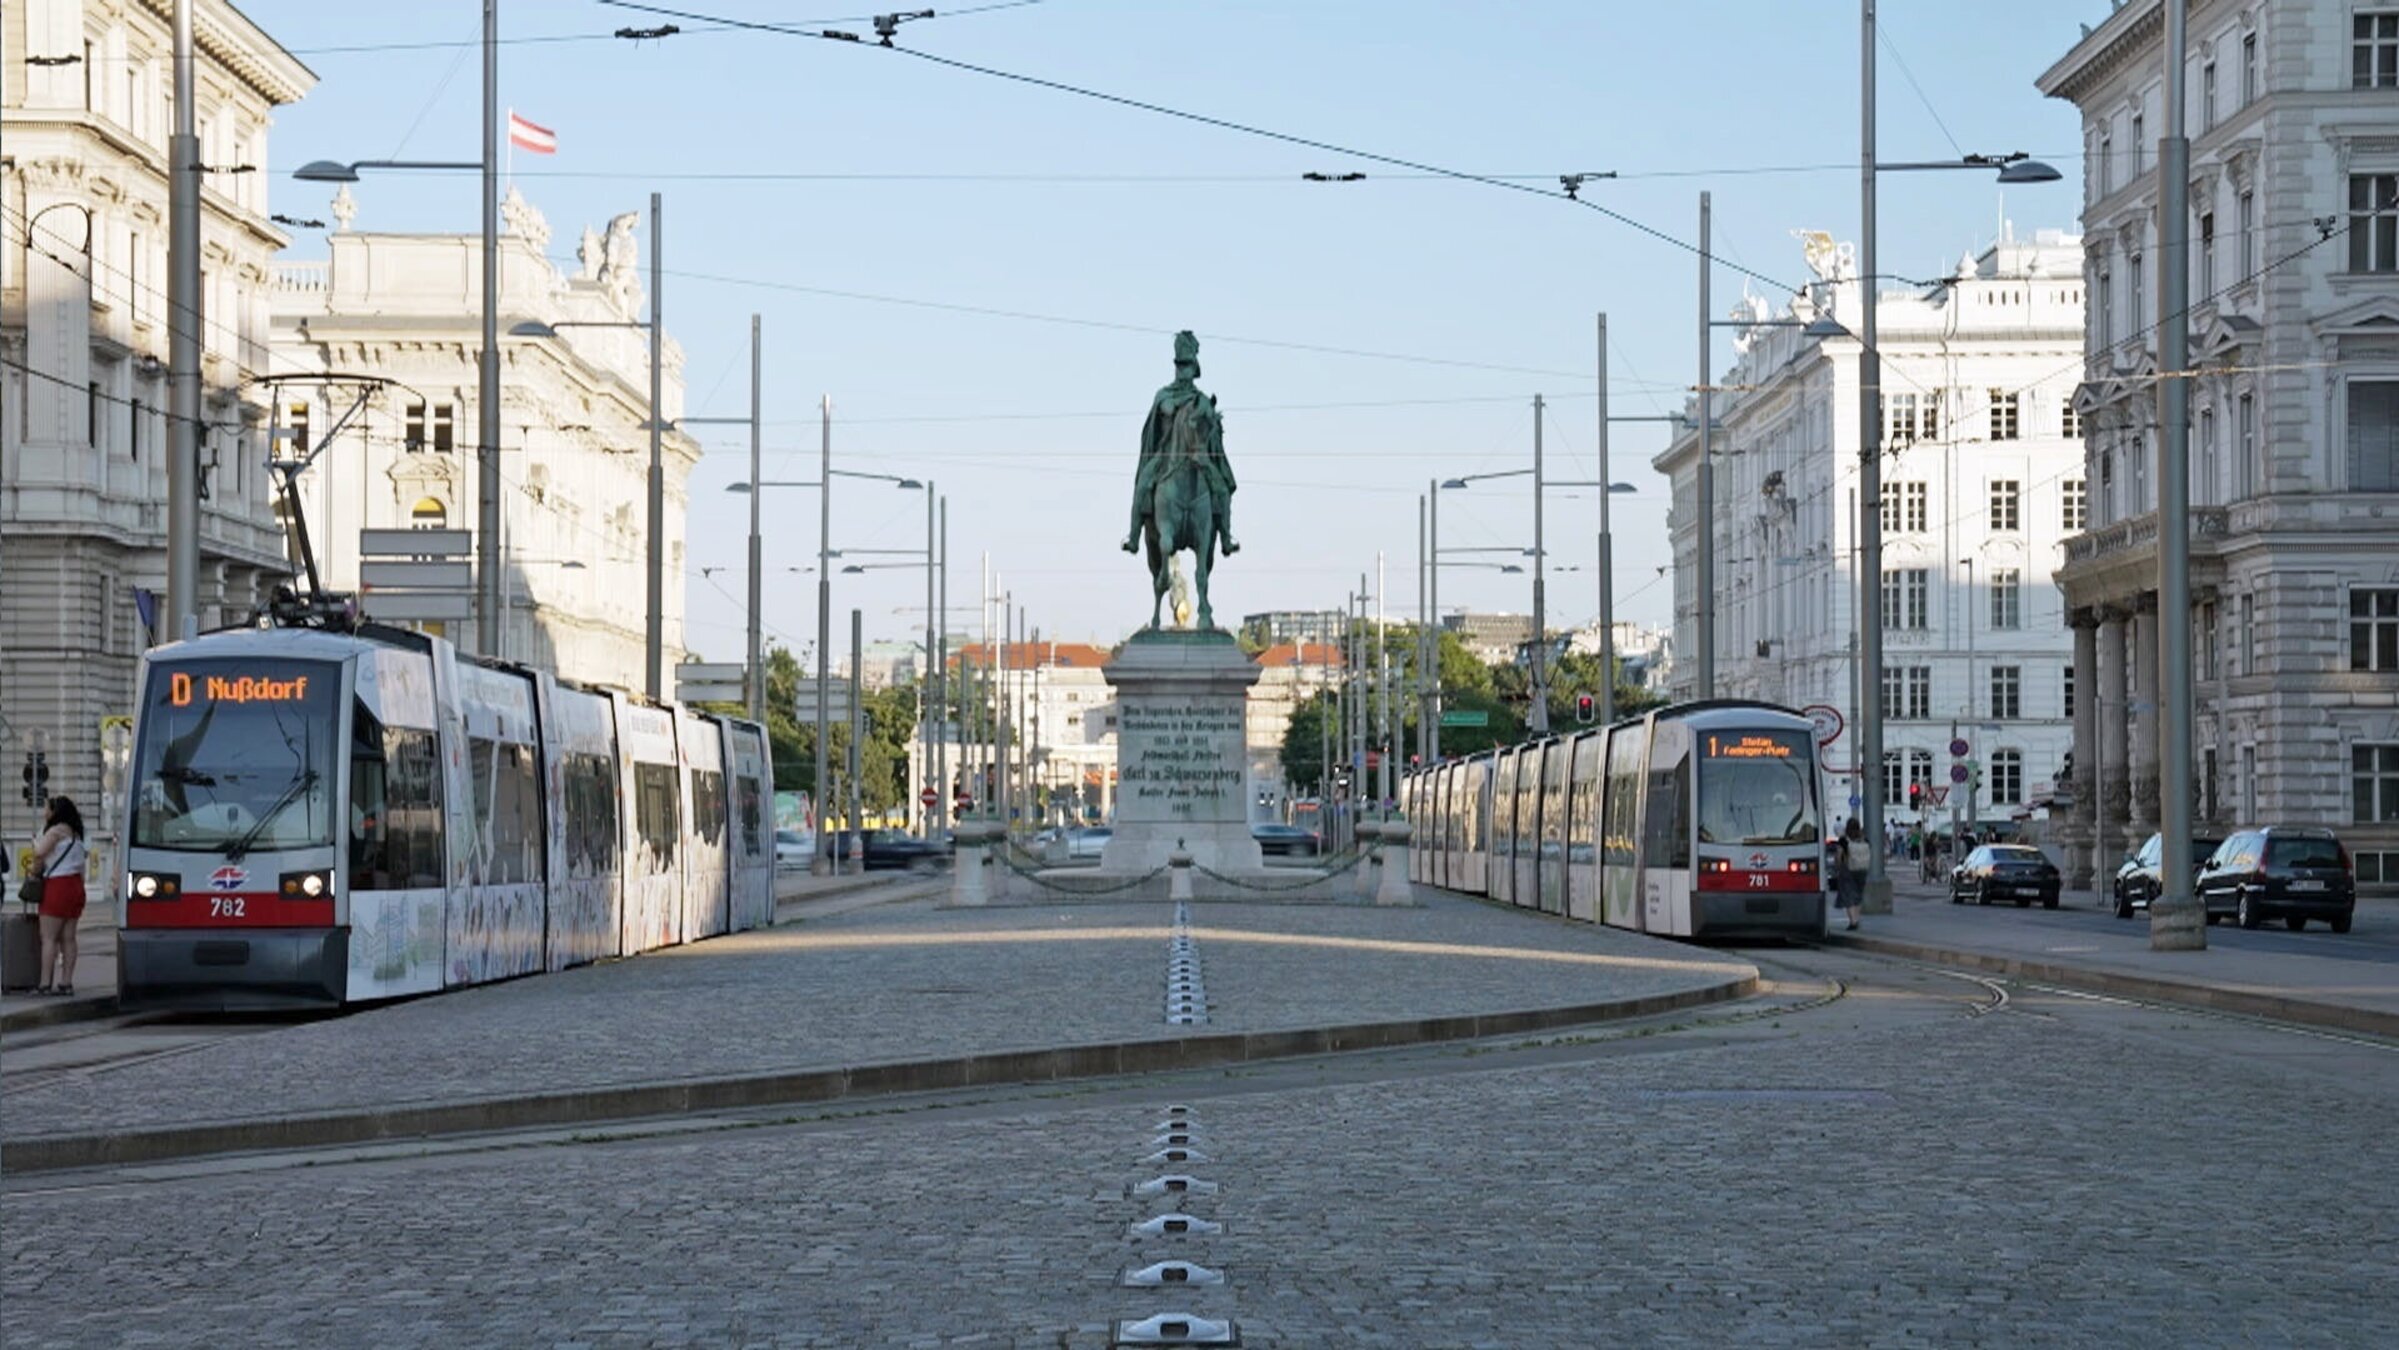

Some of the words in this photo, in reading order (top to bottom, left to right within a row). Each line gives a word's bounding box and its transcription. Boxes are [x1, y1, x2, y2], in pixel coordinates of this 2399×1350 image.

[172, 673, 191, 706] D
[207, 675, 308, 703] Nußdorf
[1709, 736, 1717, 758] 1
[210, 897, 245, 917] 782
